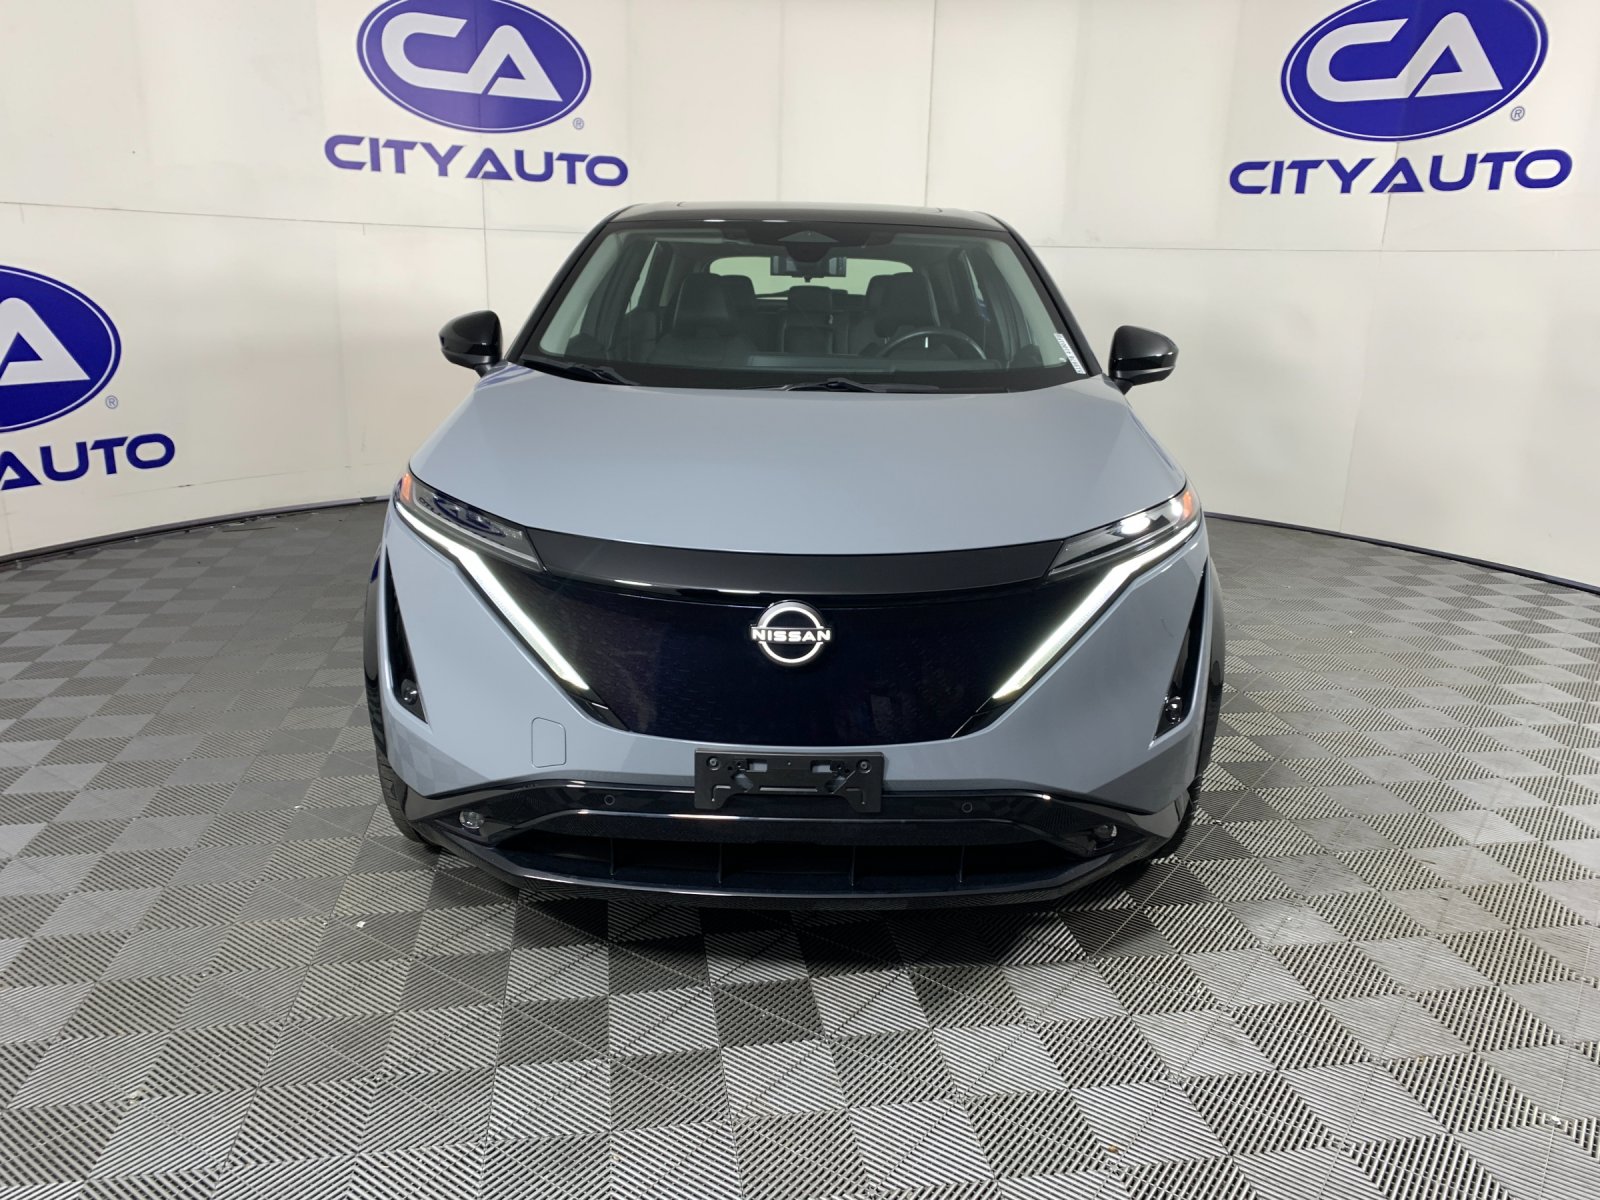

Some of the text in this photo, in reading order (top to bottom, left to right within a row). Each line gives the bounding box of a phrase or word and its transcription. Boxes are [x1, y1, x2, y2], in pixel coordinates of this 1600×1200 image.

[382, 12, 563, 102] CA
[1306, 11, 1503, 102] CA
[324, 134, 629, 187] CITY AUTO
[1229, 149, 1573, 194] CITY AUTO
[751, 629, 831, 642] NISSAN
